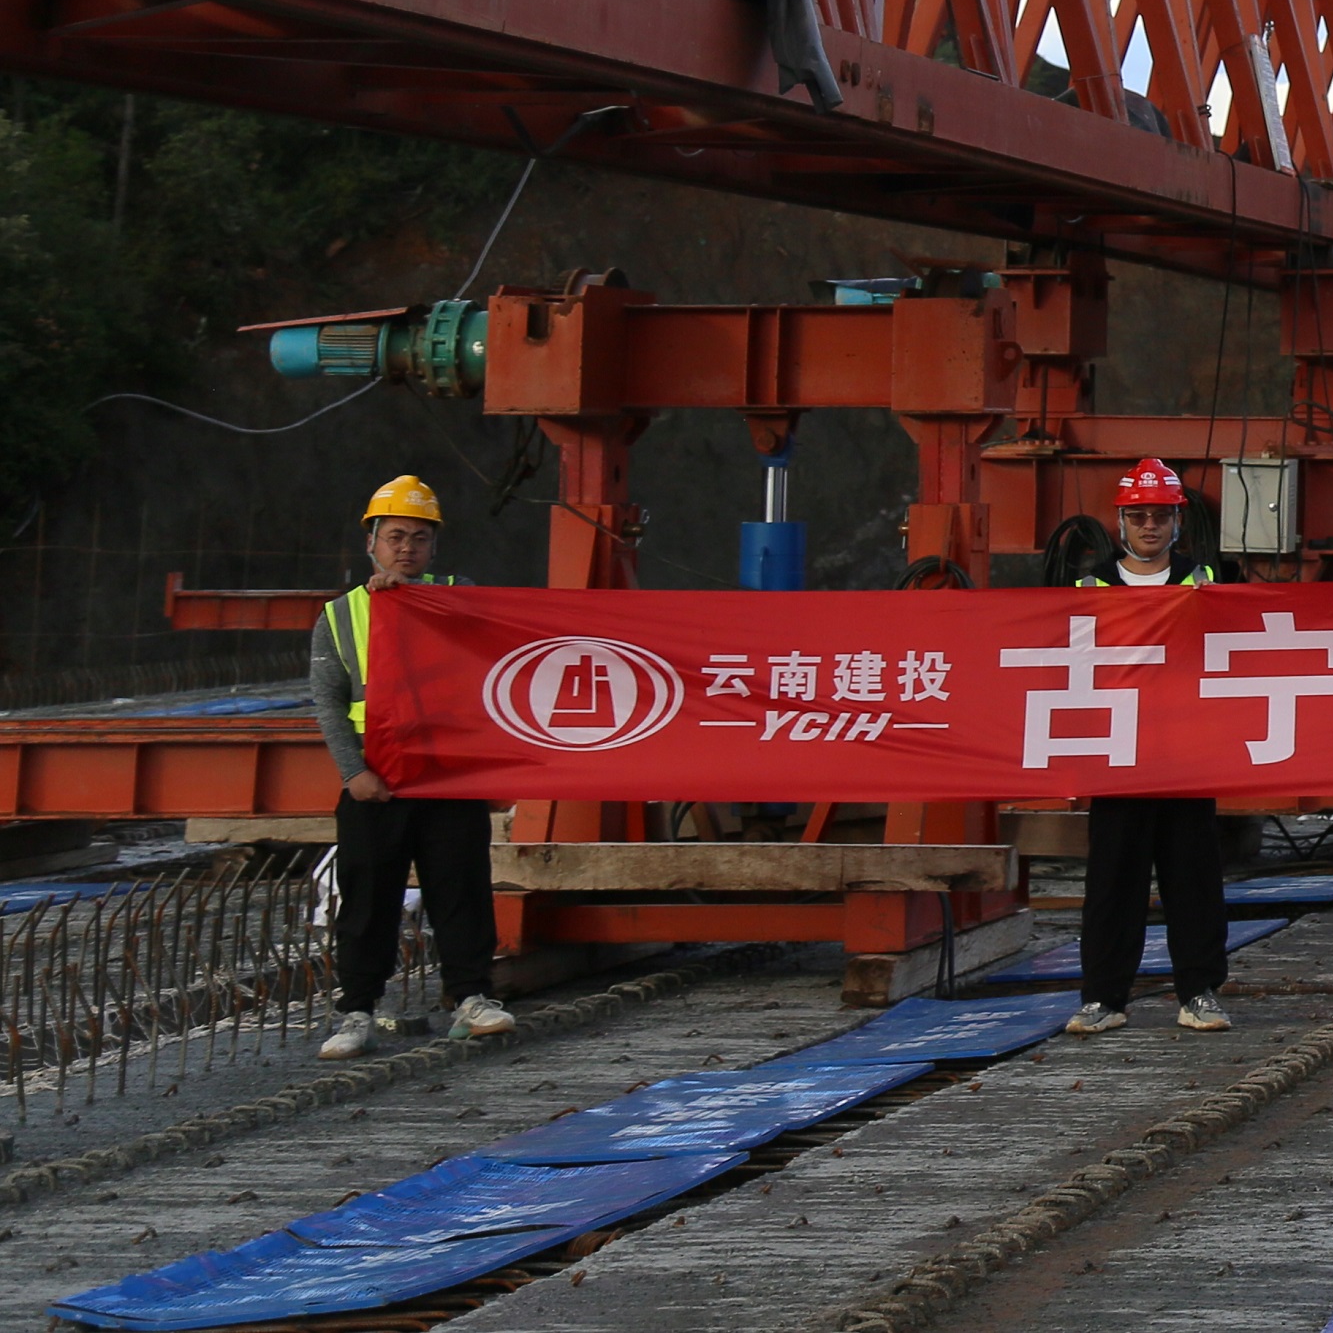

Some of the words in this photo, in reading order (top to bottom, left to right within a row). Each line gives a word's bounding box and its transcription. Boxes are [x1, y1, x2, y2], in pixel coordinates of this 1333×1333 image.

[701, 651, 953, 702] 云南建投
[760, 710, 893, 742] YCIH
